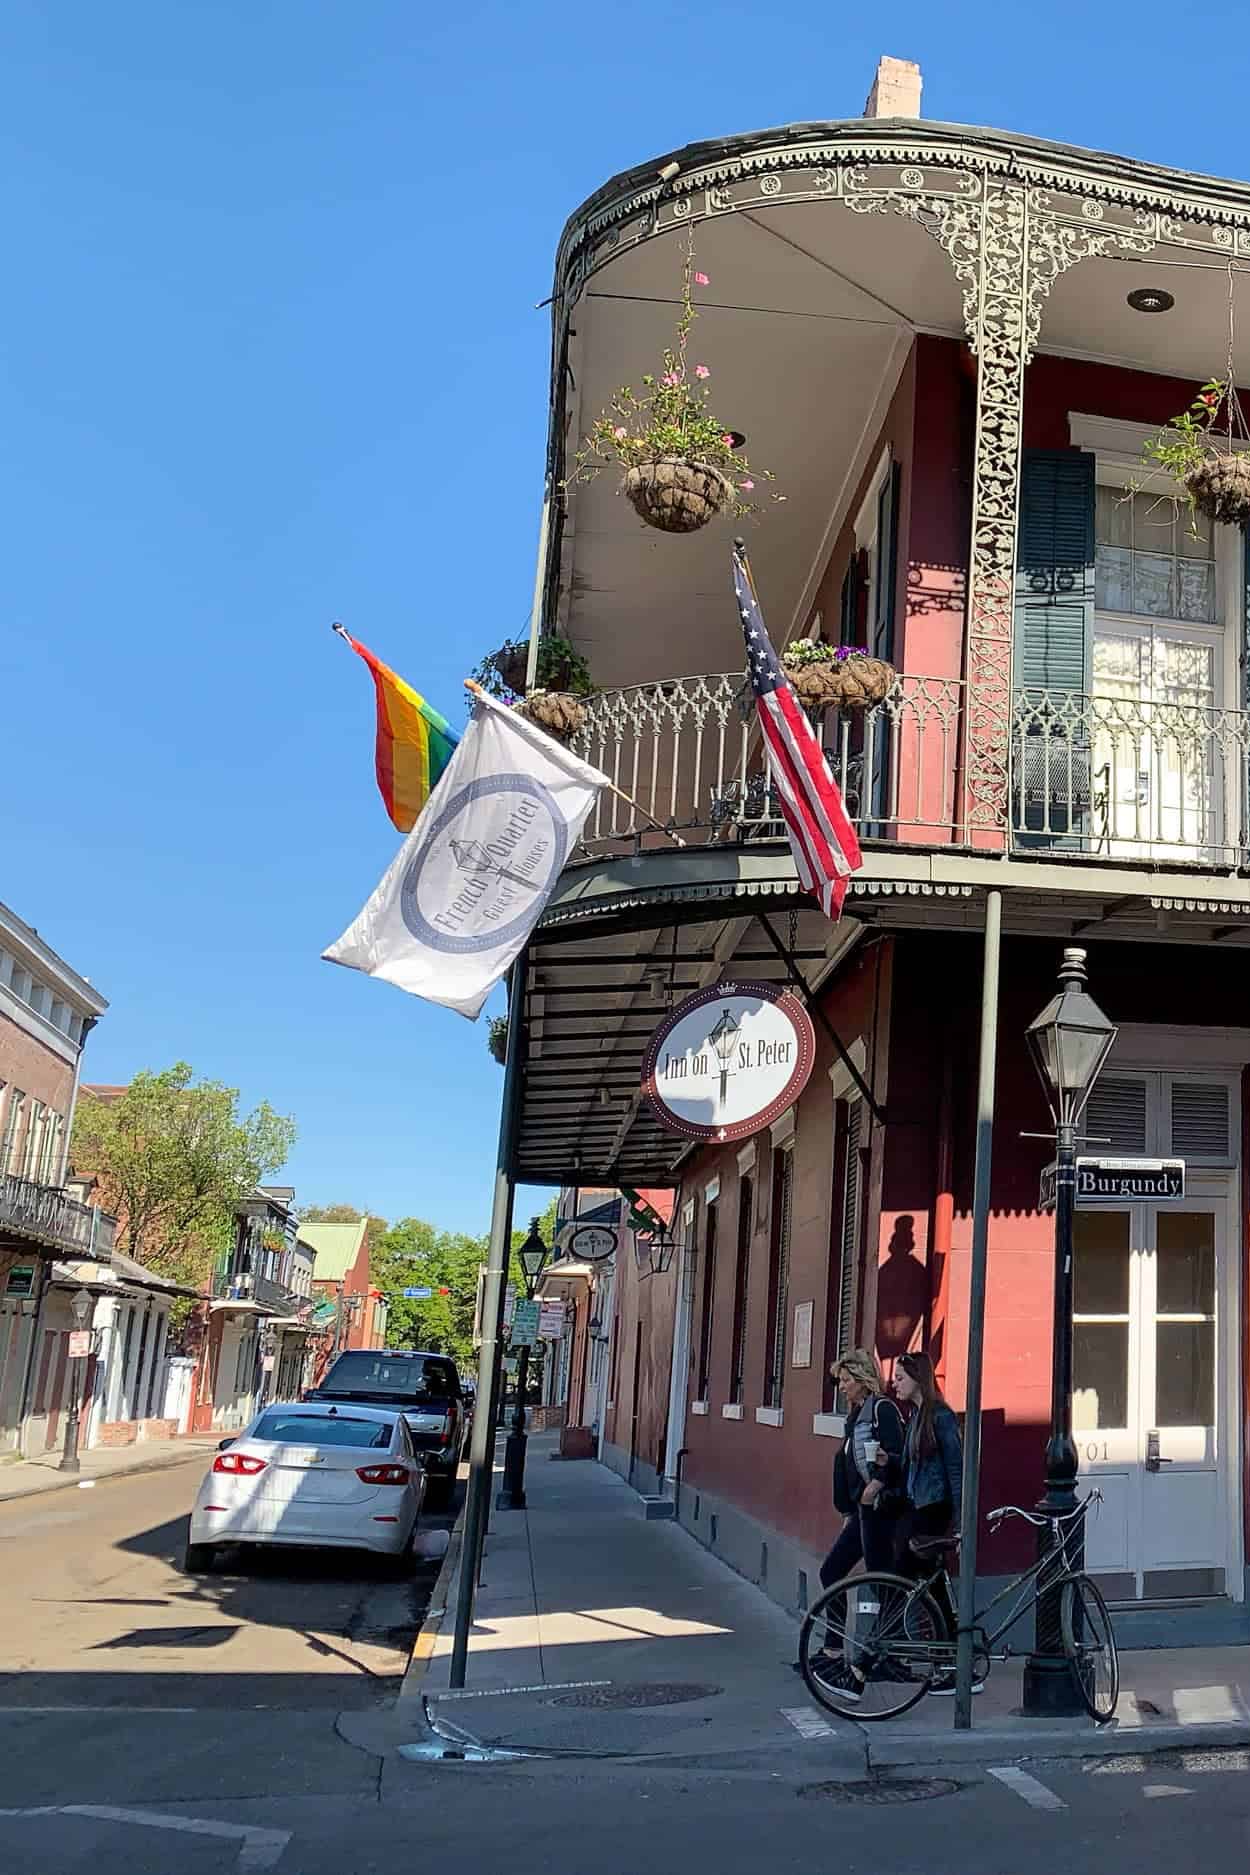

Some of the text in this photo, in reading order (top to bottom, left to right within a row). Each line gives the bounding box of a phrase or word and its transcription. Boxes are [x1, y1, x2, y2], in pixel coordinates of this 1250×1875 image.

[433, 798, 540, 932] French Quarter
[482, 840, 549, 921] Guest Houses
[664, 1039, 792, 1081] Inn on St. Peter
[1080, 1171, 1181, 1198] Burgundy
[1078, 1441, 1111, 1462] 01
